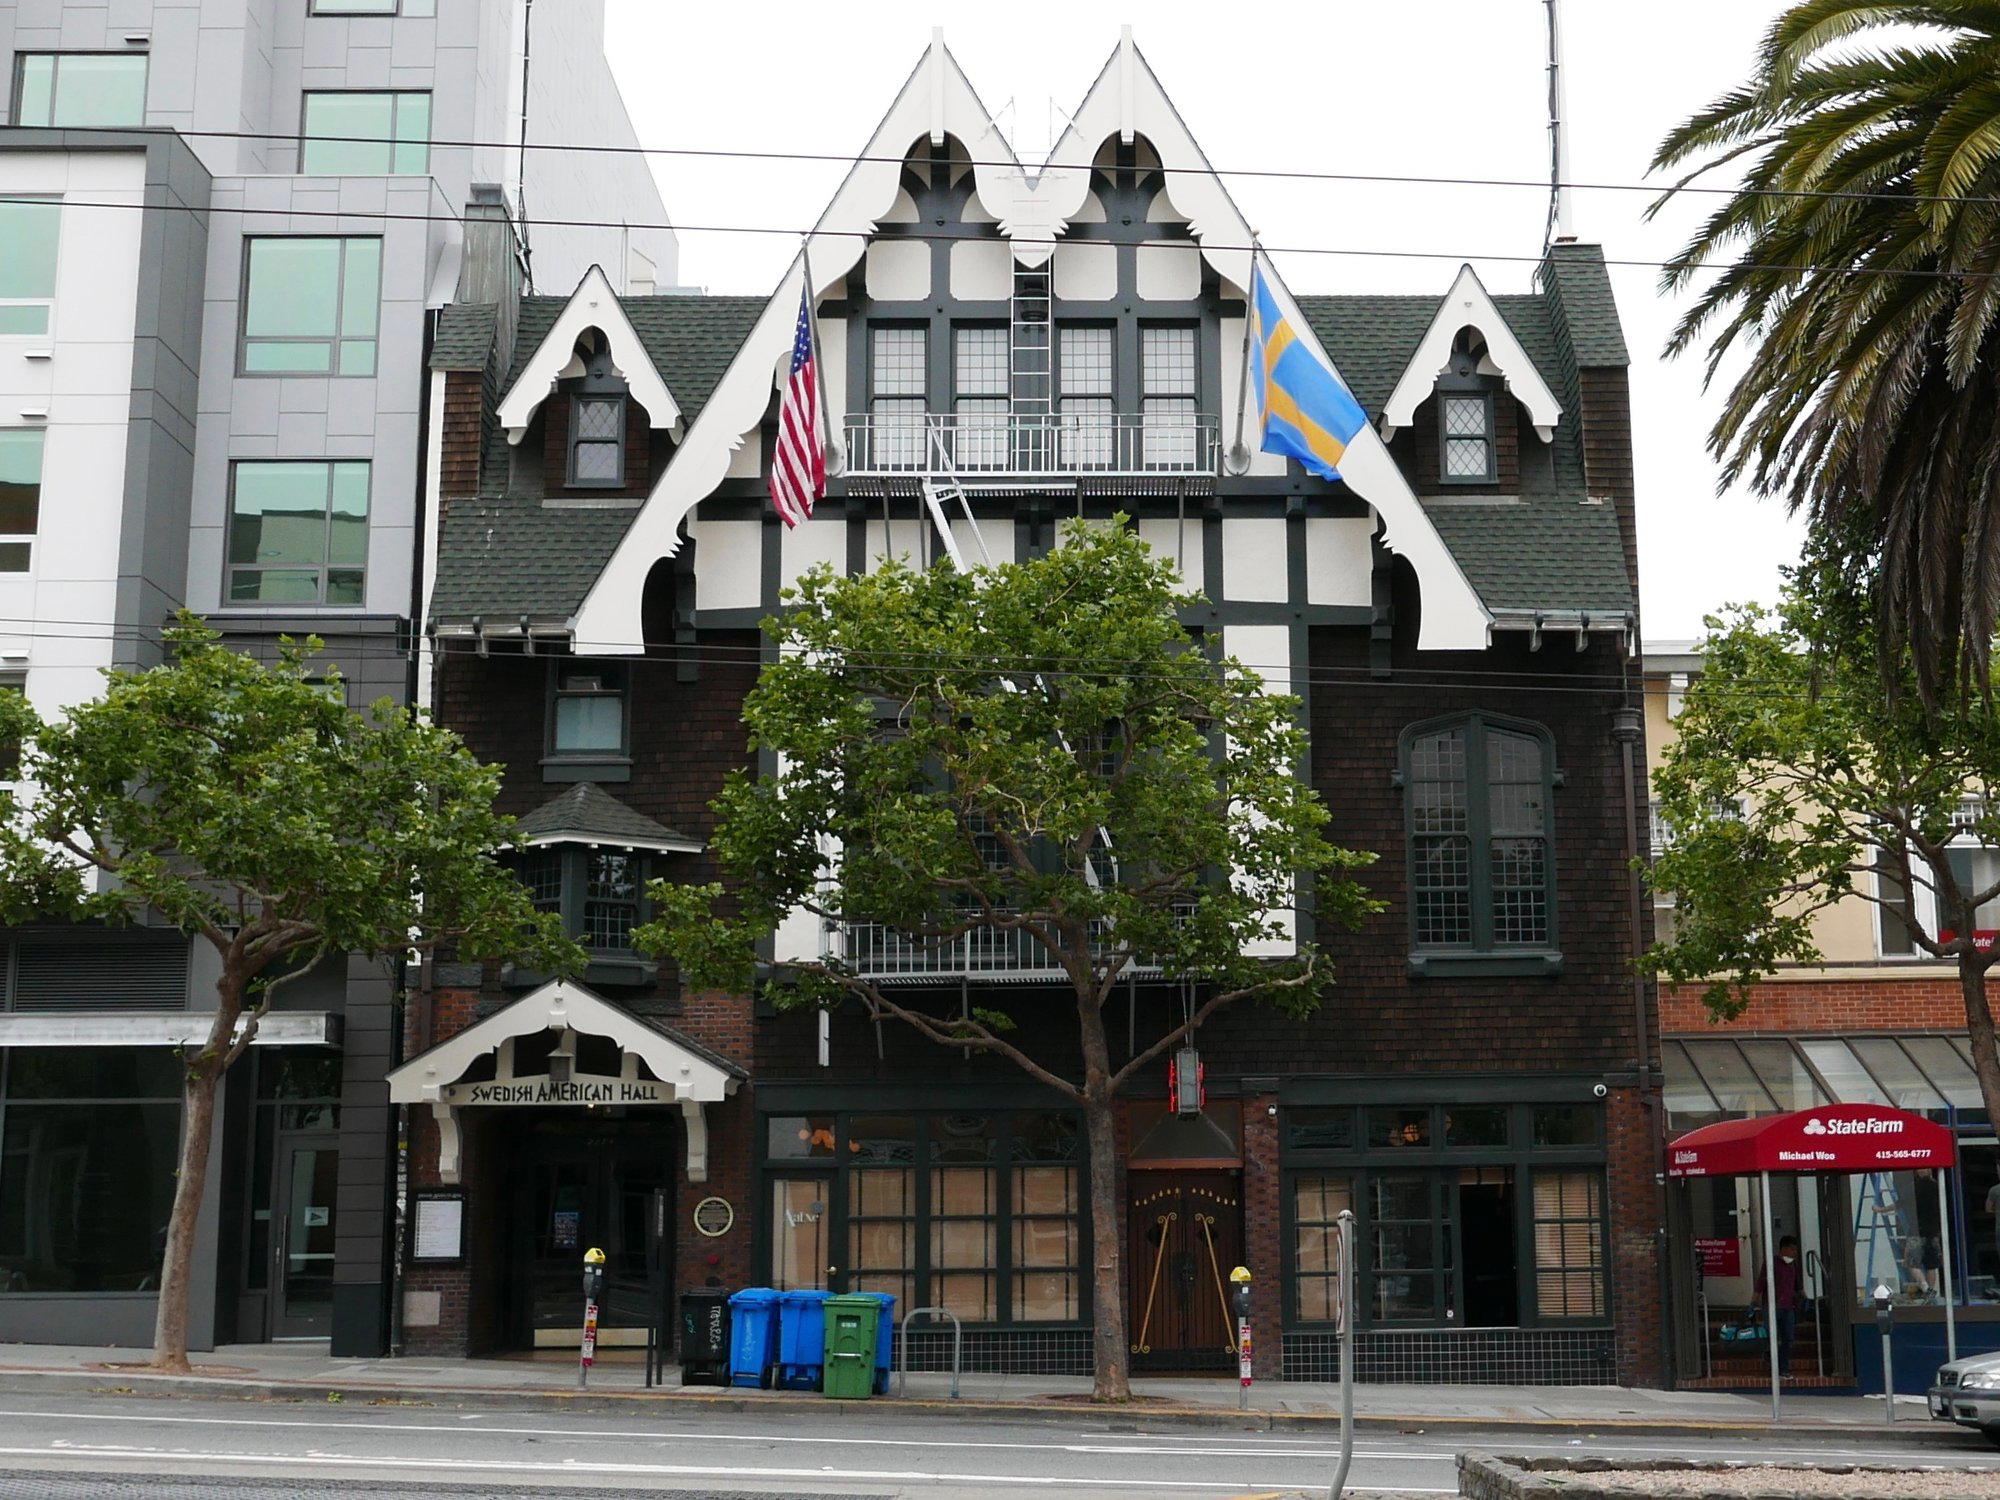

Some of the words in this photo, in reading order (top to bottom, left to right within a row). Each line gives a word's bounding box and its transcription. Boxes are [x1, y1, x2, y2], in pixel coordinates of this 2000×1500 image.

[471, 1085, 533, 1102] SWEDISH
[535, 1082, 613, 1103] AMERICAN
[621, 1083, 659, 1101] HALL
[1778, 1151, 1815, 1161] Michael
[1815, 1151, 1836, 1161] Woo
[1875, 1149, 1931, 1160] 415-565-6777
